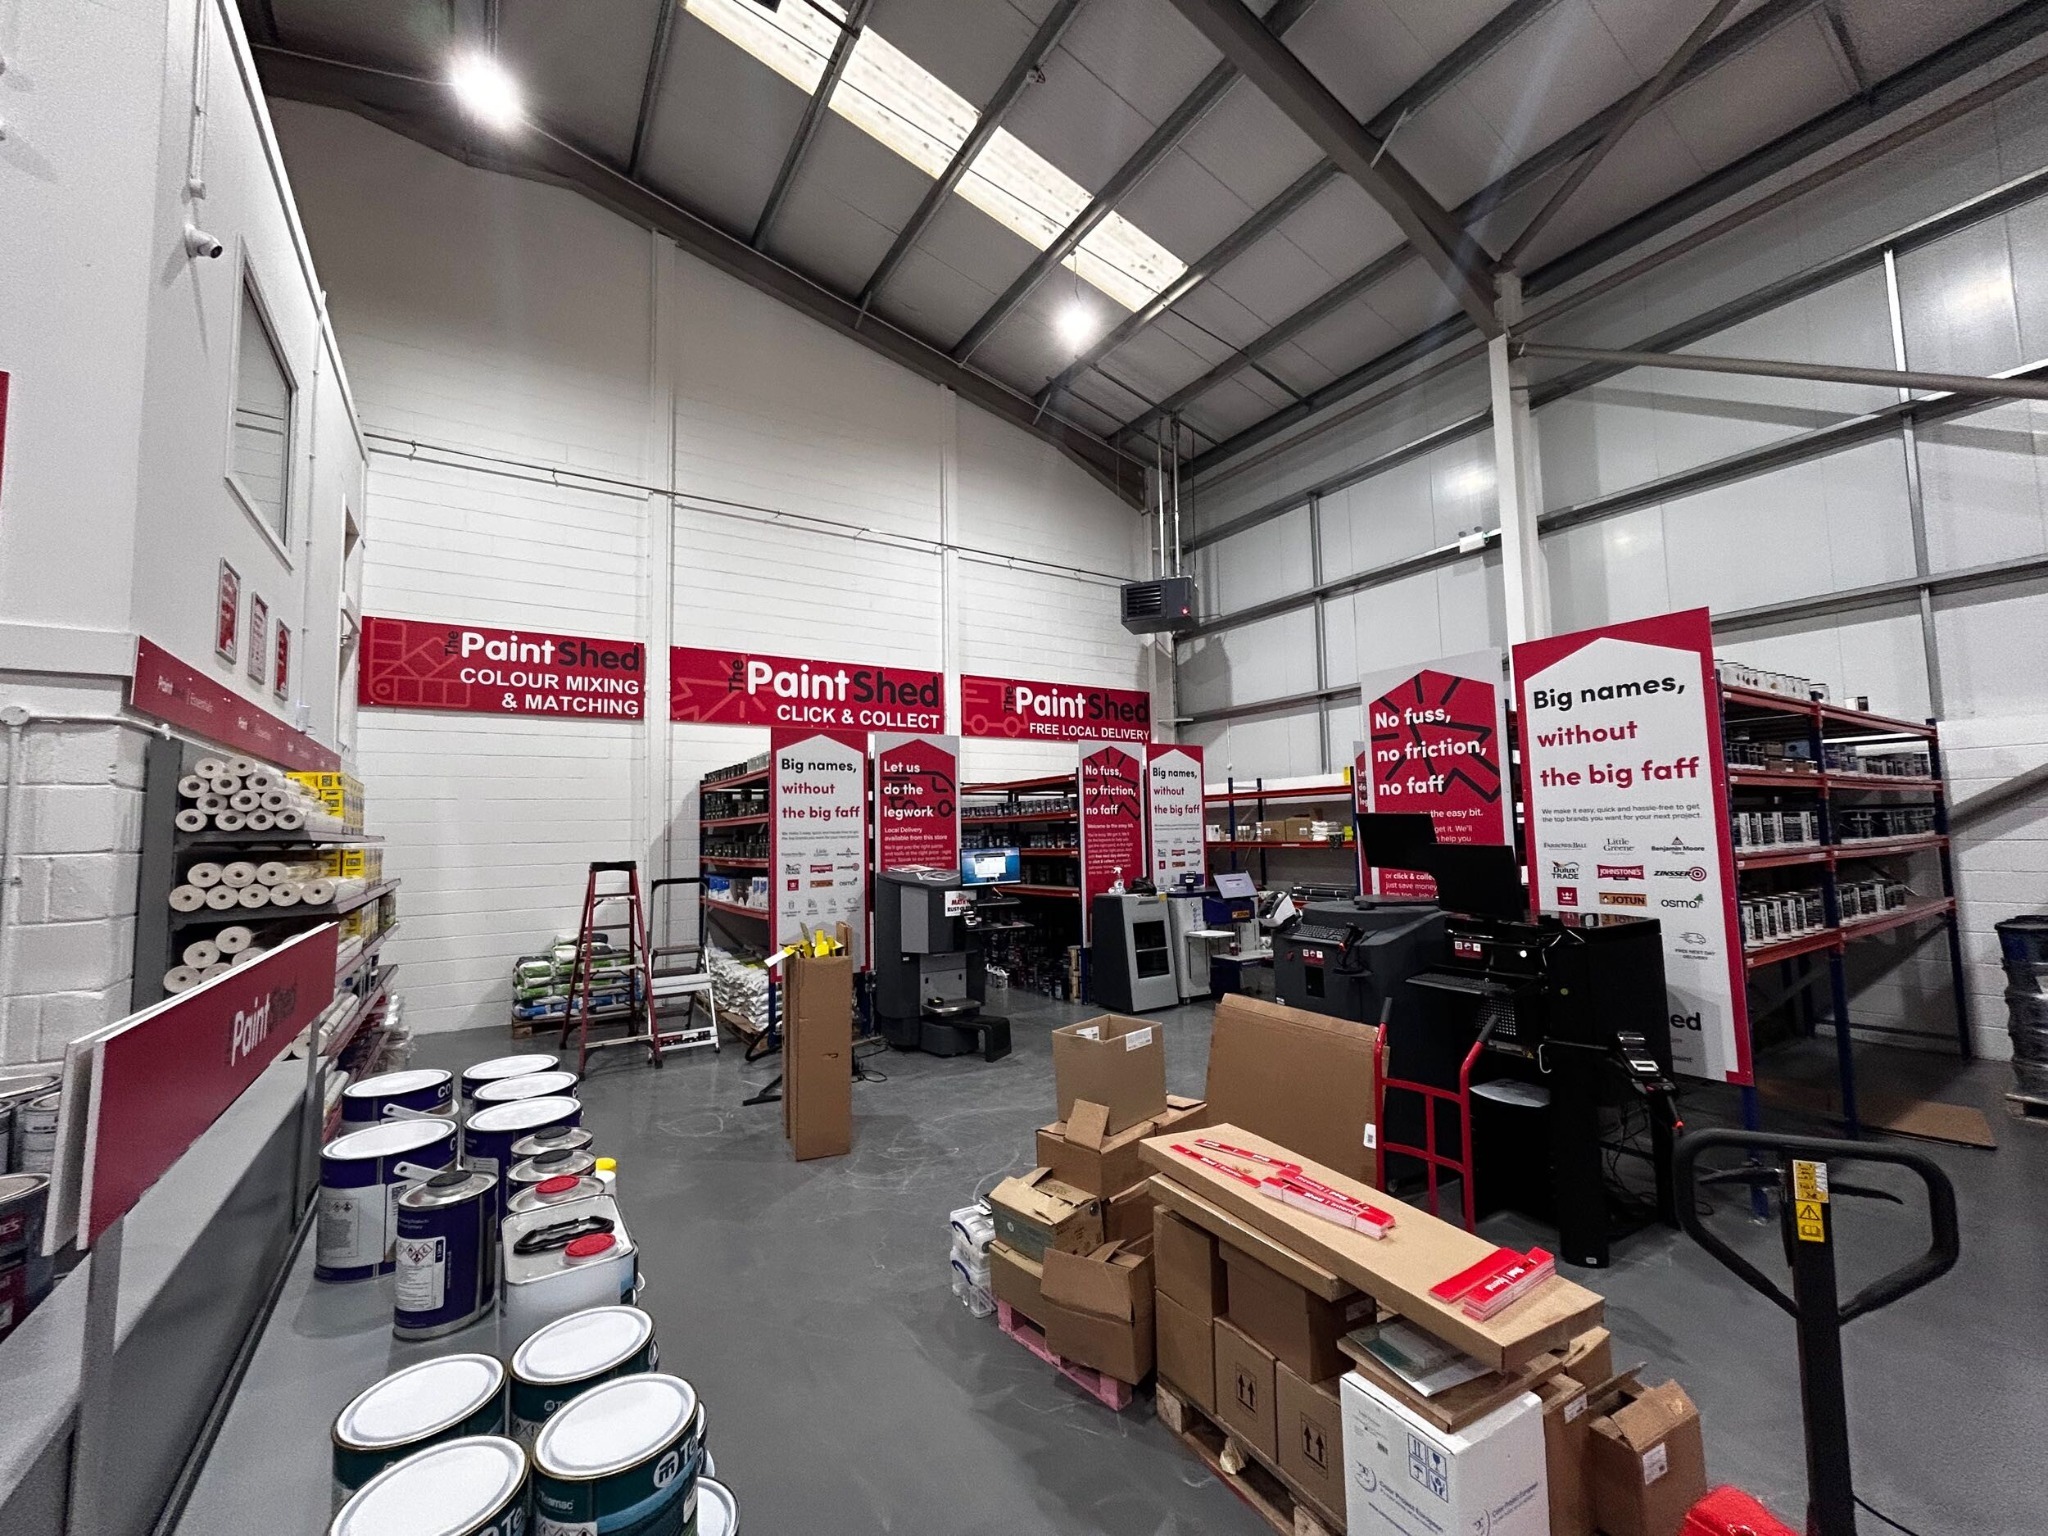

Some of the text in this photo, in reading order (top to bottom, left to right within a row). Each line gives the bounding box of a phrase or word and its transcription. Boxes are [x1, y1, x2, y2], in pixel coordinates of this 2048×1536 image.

[445, 630, 459, 656] The
[460, 667, 639, 695] COLOUR MIXING
[728, 658, 744, 693] The
[1003, 686, 1016, 712] The
[1533, 676, 1685, 712] Big names,
[502, 692, 639, 715] & MATCHING
[776, 704, 940, 729] CLICK & COLLECT
[1375, 707, 1451, 729] No fuss,
[1030, 722, 1149, 741] FREE LOCAL DELIVERY
[1537, 721, 1638, 747] without
[1377, 738, 1486, 763] no friction,
[781, 758, 857, 773] Big names,
[884, 761, 920, 773] Let us
[1085, 765, 1122, 777] No fuss,
[1540, 756, 1699, 788] the big faff
[1153, 768, 1198, 779] Big names,
[782, 782, 835, 794] without
[884, 784, 923, 795] do the
[1086, 785, 1136, 797] no friction,
[1154, 787, 1185, 795] without
[1379, 774, 1444, 796] no faff
[782, 806, 860, 821] the big faff
[884, 806, 934, 820] legwork
[1086, 805, 1118, 815] no faff
[1154, 805, 1200, 816] the big faff
[1430, 808, 1483, 819] the easy bit.
[1633, 804, 1674, 812] hassle-free
[1686, 803, 1700, 811] get
[1434, 826, 1445, 834] get
[1441, 835, 1456, 843] help
[1612, 895, 1645, 905] JOTUN
[231, 992, 271, 1067] Paint
